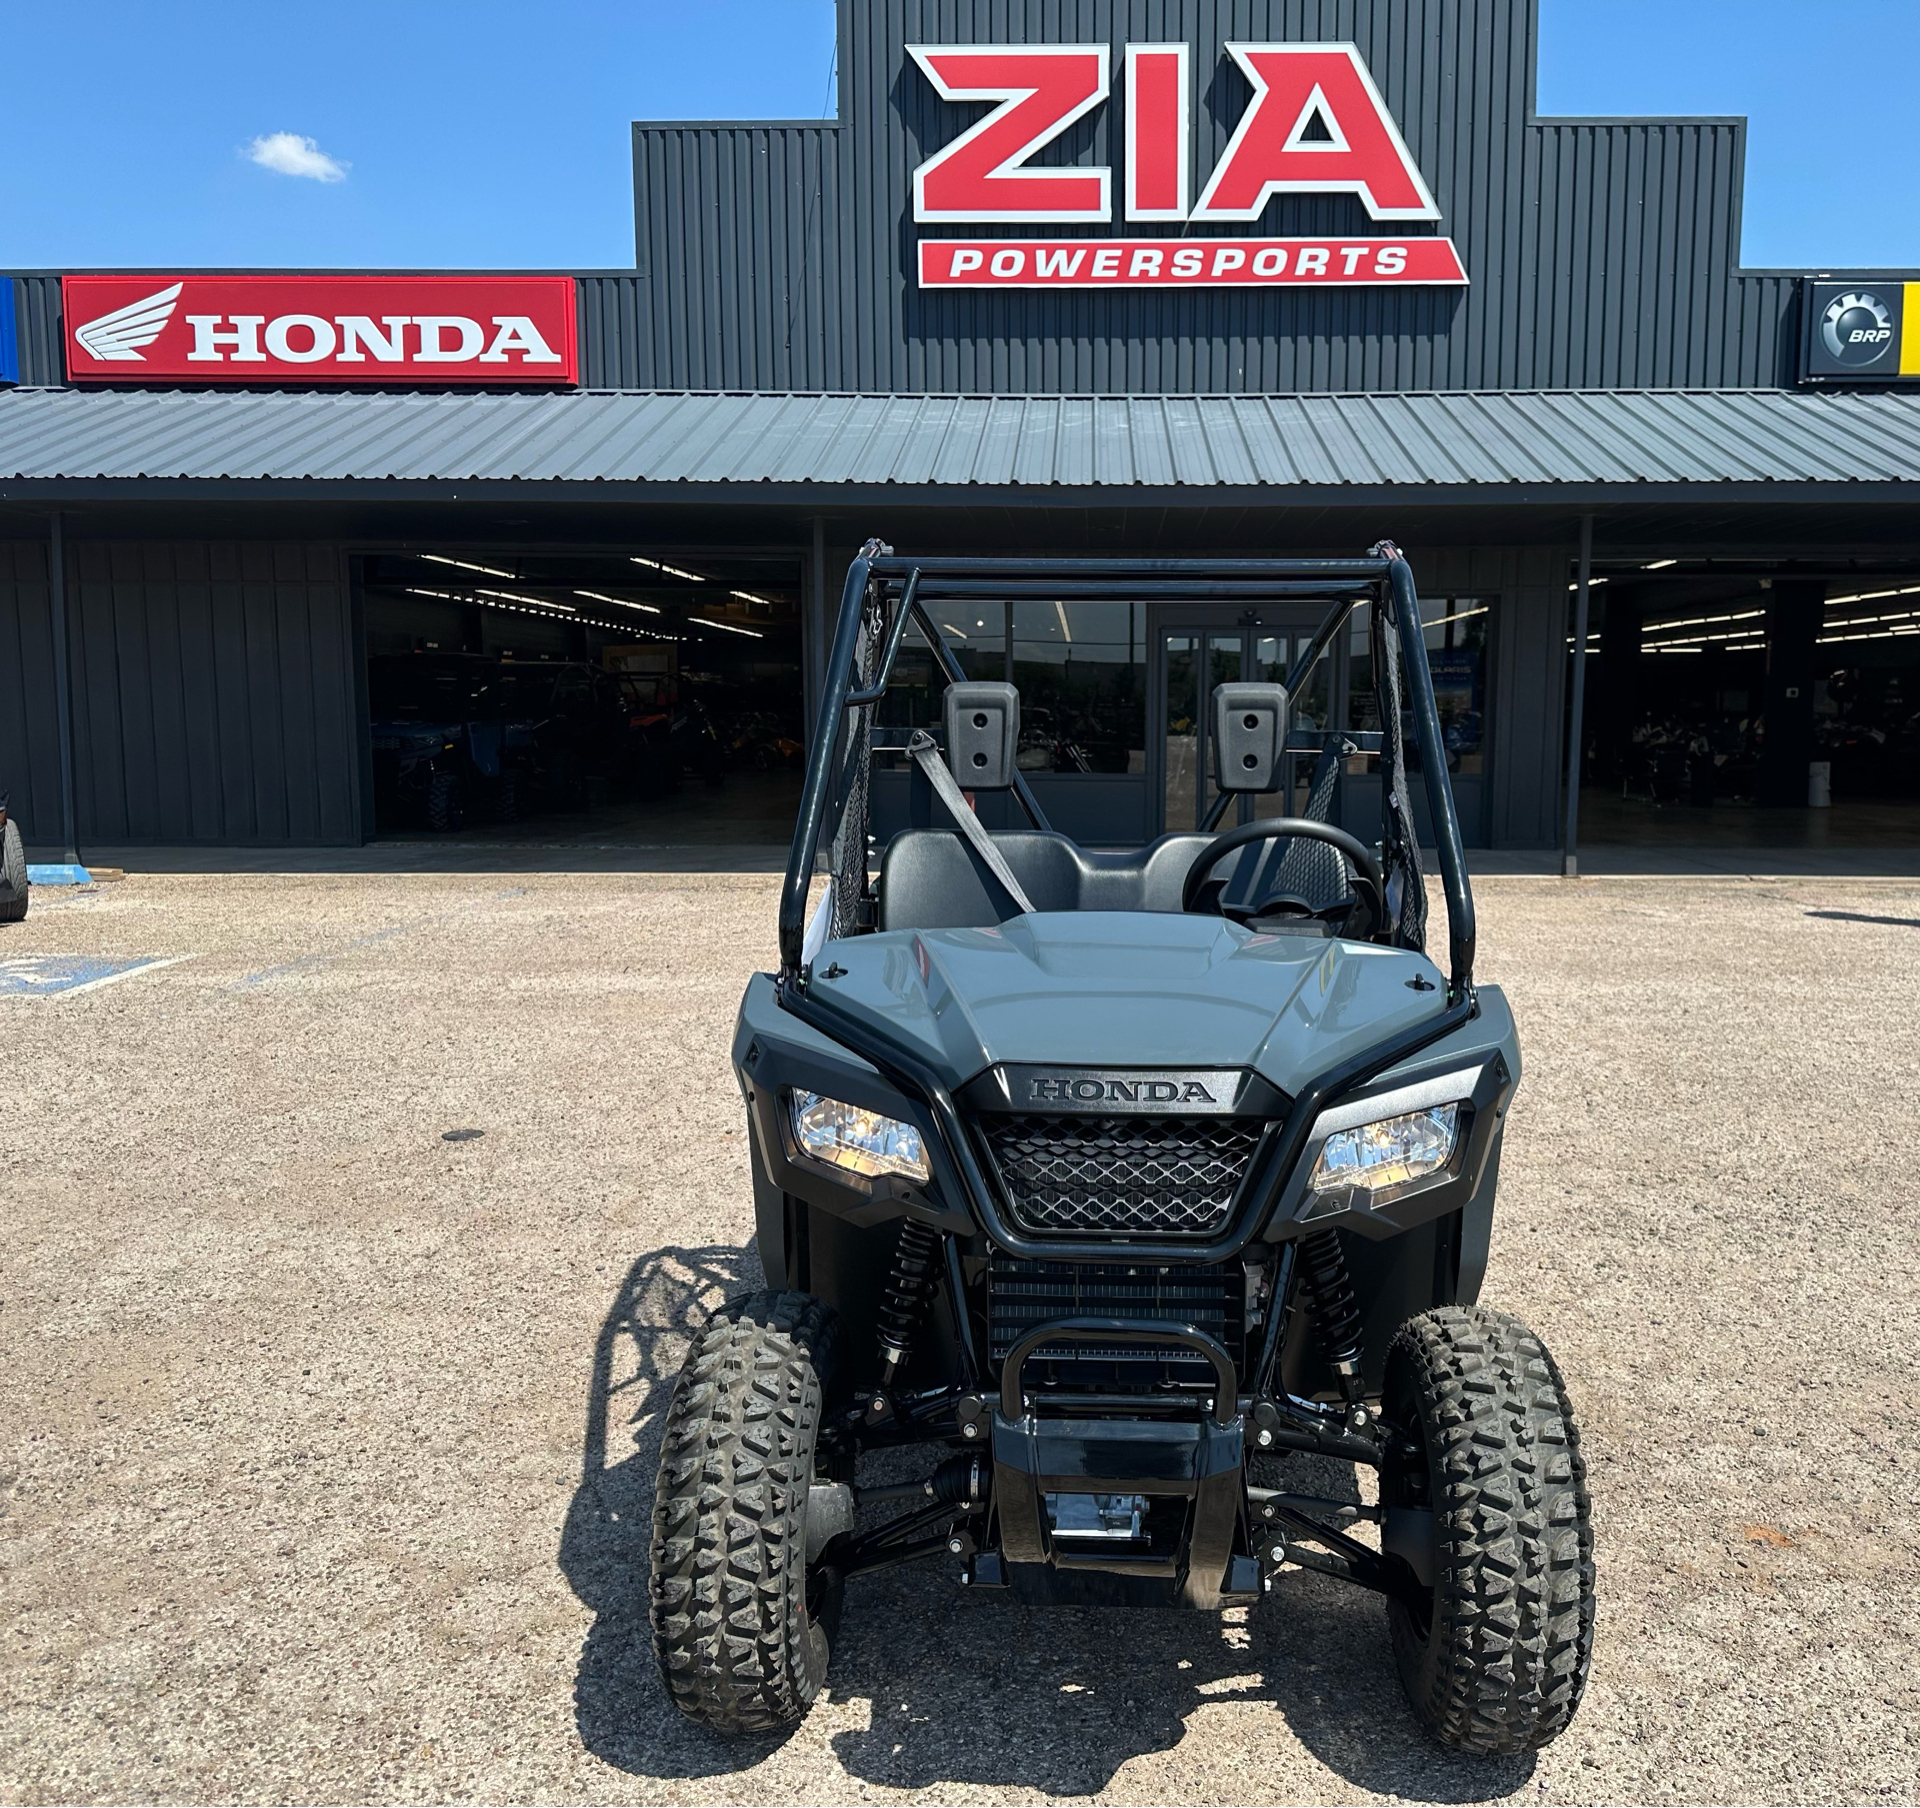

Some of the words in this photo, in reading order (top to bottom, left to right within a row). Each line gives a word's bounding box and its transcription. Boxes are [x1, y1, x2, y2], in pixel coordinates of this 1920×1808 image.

[904, 42, 1442, 222] ZIA
[949, 246, 1408, 277] POWERSPORTS
[186, 315, 561, 363] HONDA
[1849, 329, 1890, 342] BRP
[1031, 1078, 1217, 1103] HONDA
